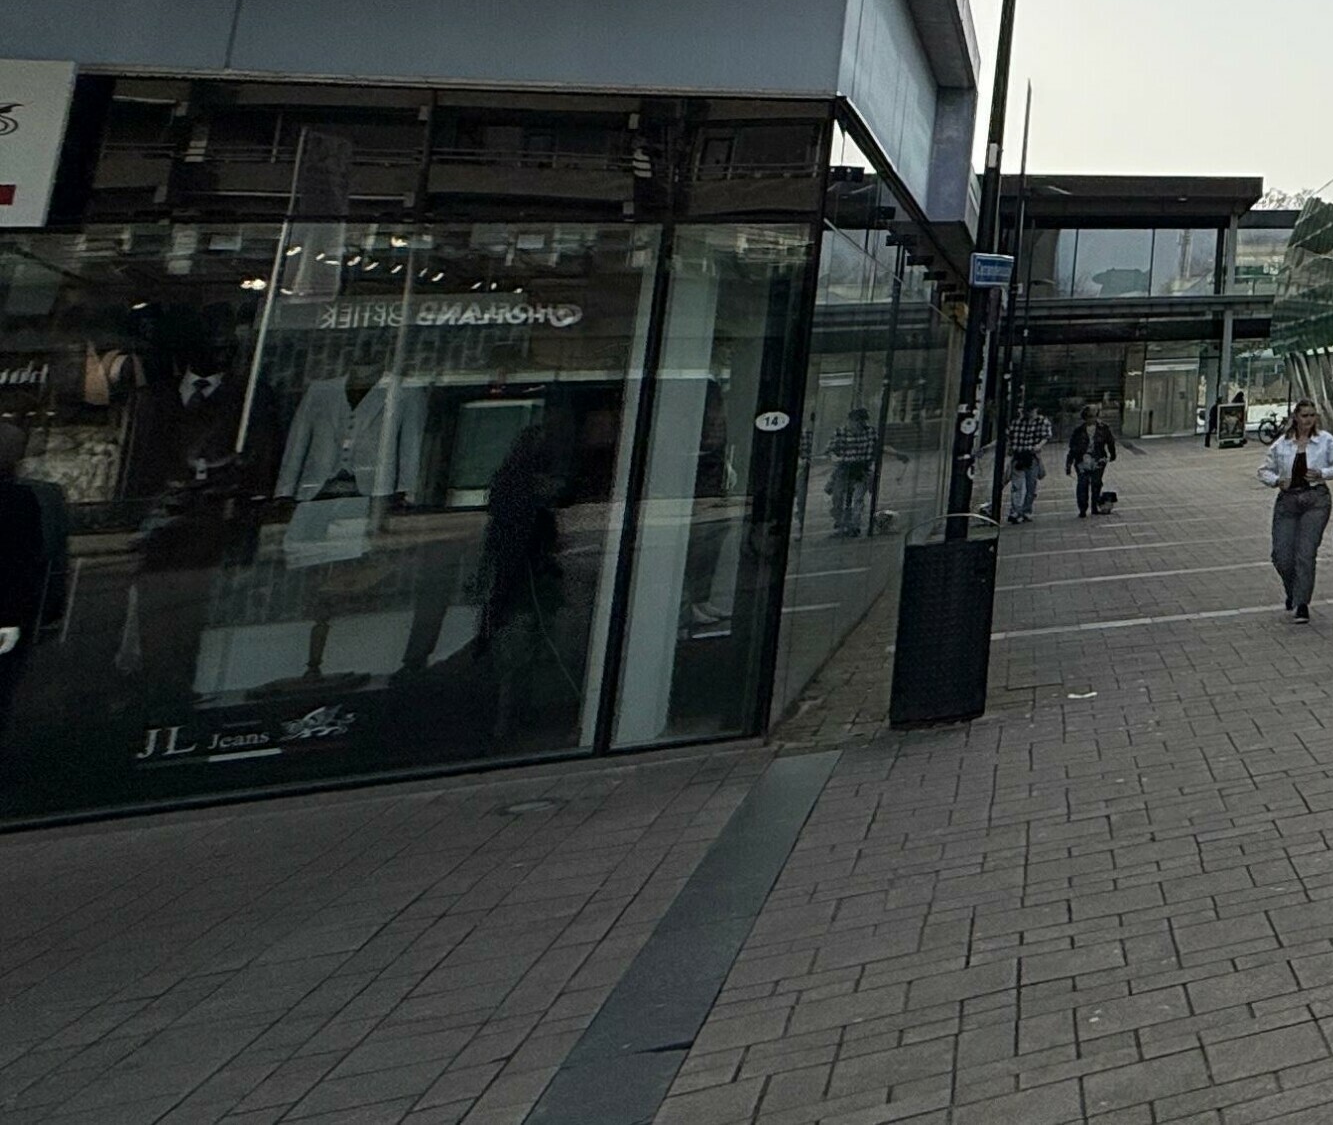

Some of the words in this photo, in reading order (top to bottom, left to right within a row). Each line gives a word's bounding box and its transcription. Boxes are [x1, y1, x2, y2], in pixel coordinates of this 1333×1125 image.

[764, 415, 779, 427] 14
[135, 725, 197, 759] JL
[206, 730, 271, 751] Jeans
